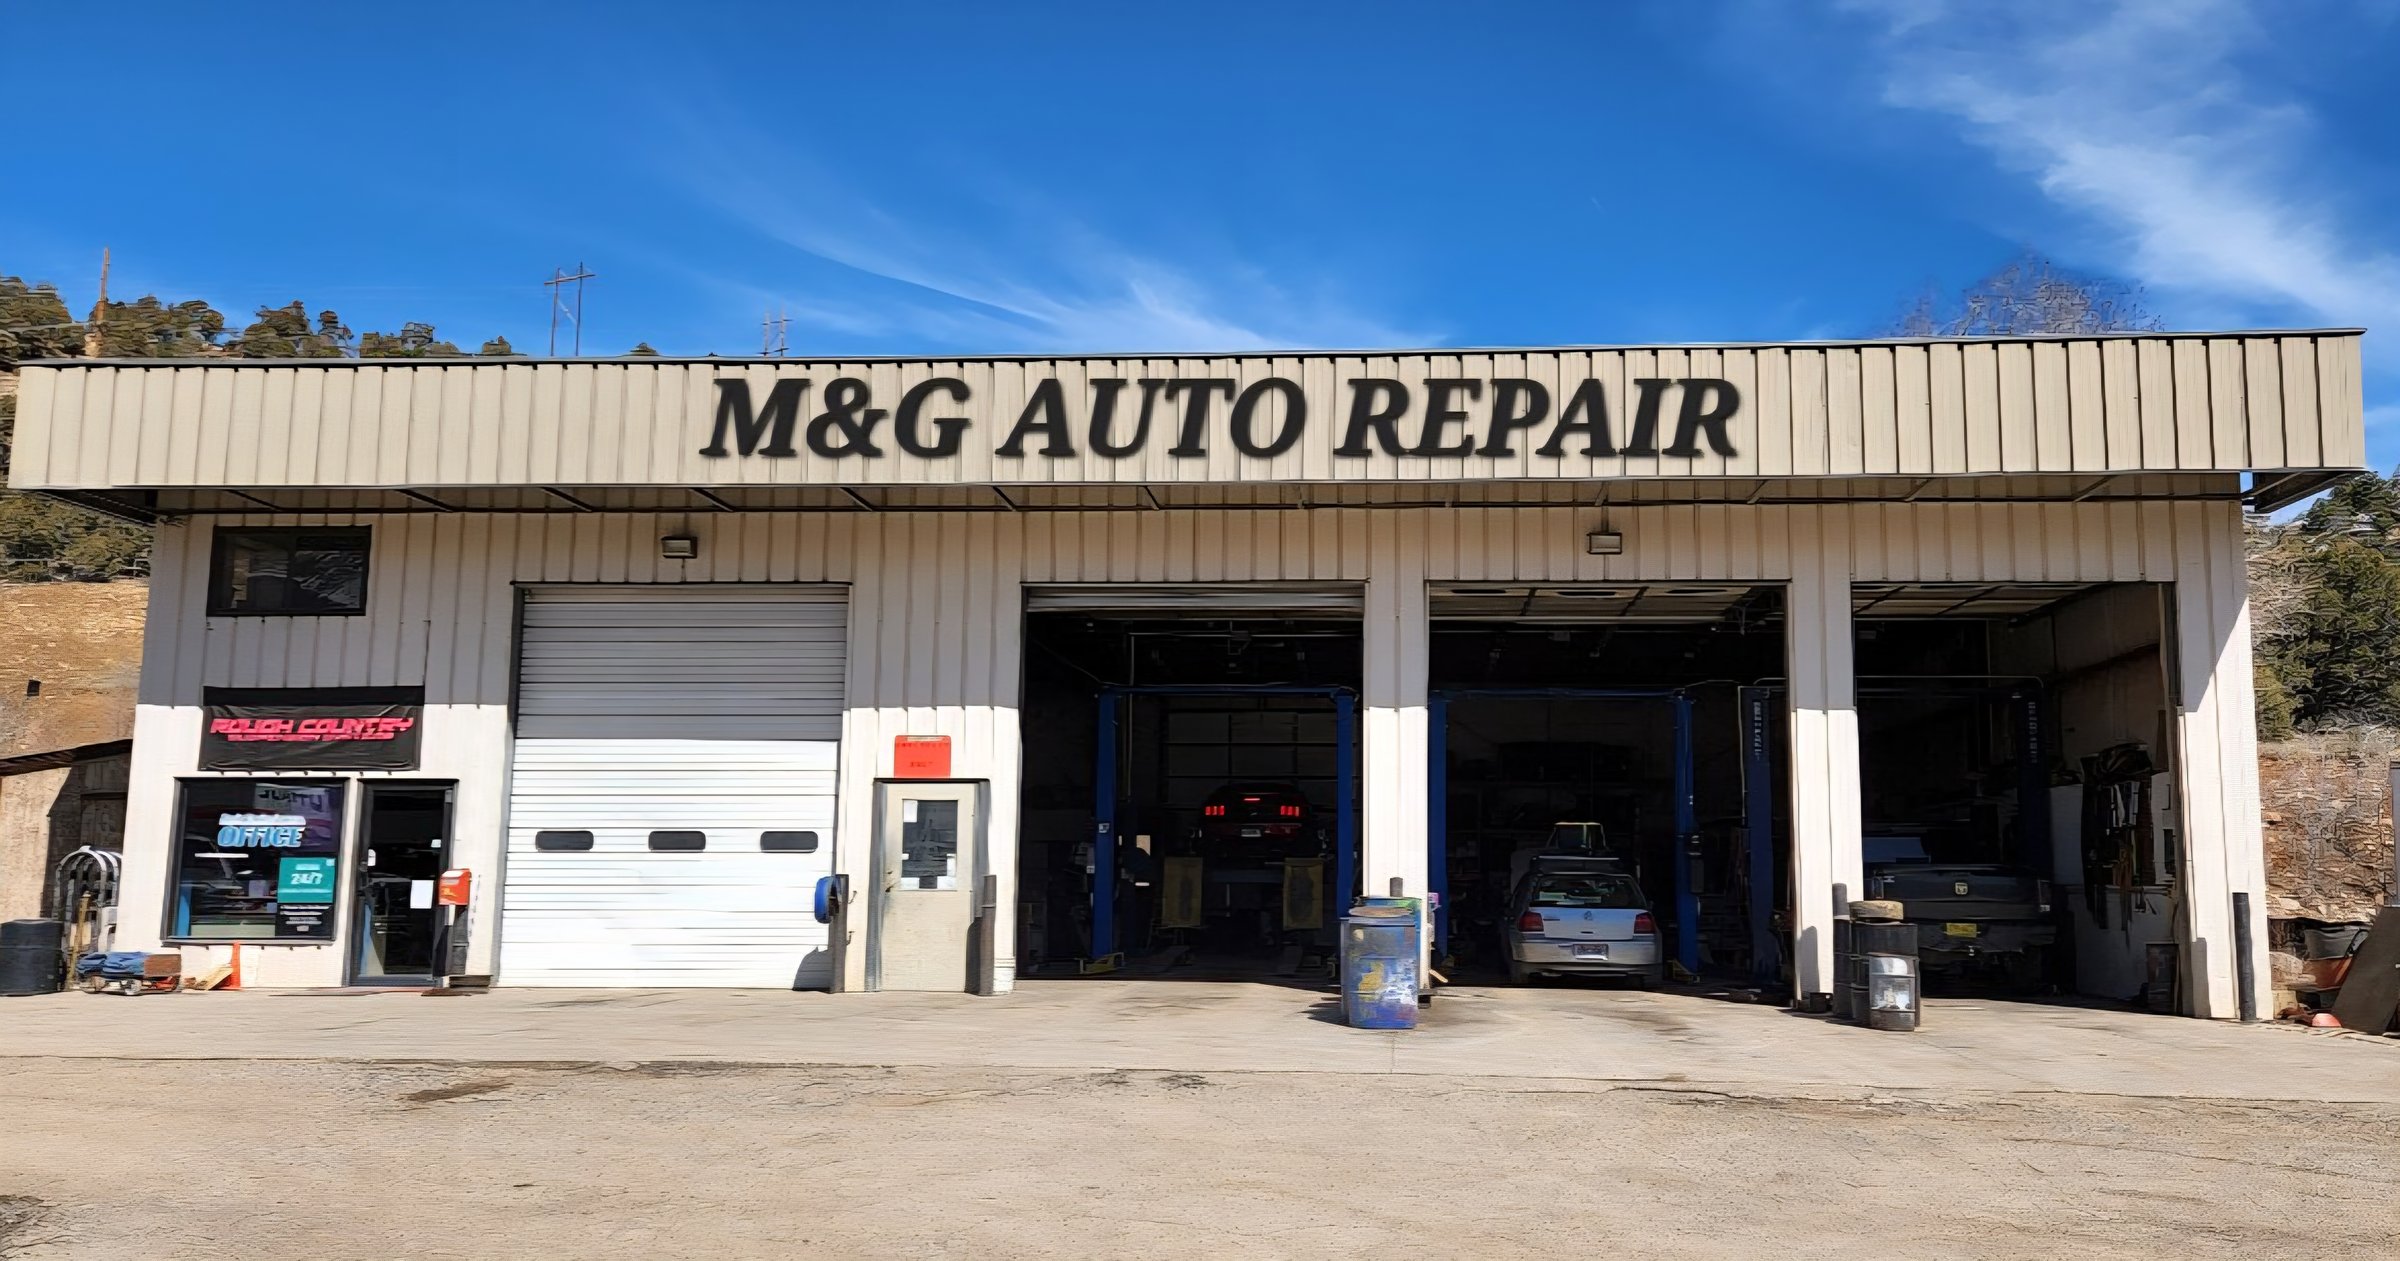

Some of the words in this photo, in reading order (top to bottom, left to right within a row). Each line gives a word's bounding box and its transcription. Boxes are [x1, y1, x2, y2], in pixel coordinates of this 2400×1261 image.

[699, 377, 972, 457] M&G
[995, 377, 1308, 457] AUTO
[1333, 377, 1740, 457] REPAIR
[210, 718, 294, 734] ROUGH
[298, 717, 414, 734] COUNTRY
[217, 825, 305, 848] OFFICE
[290, 872, 323, 885] 24/7
